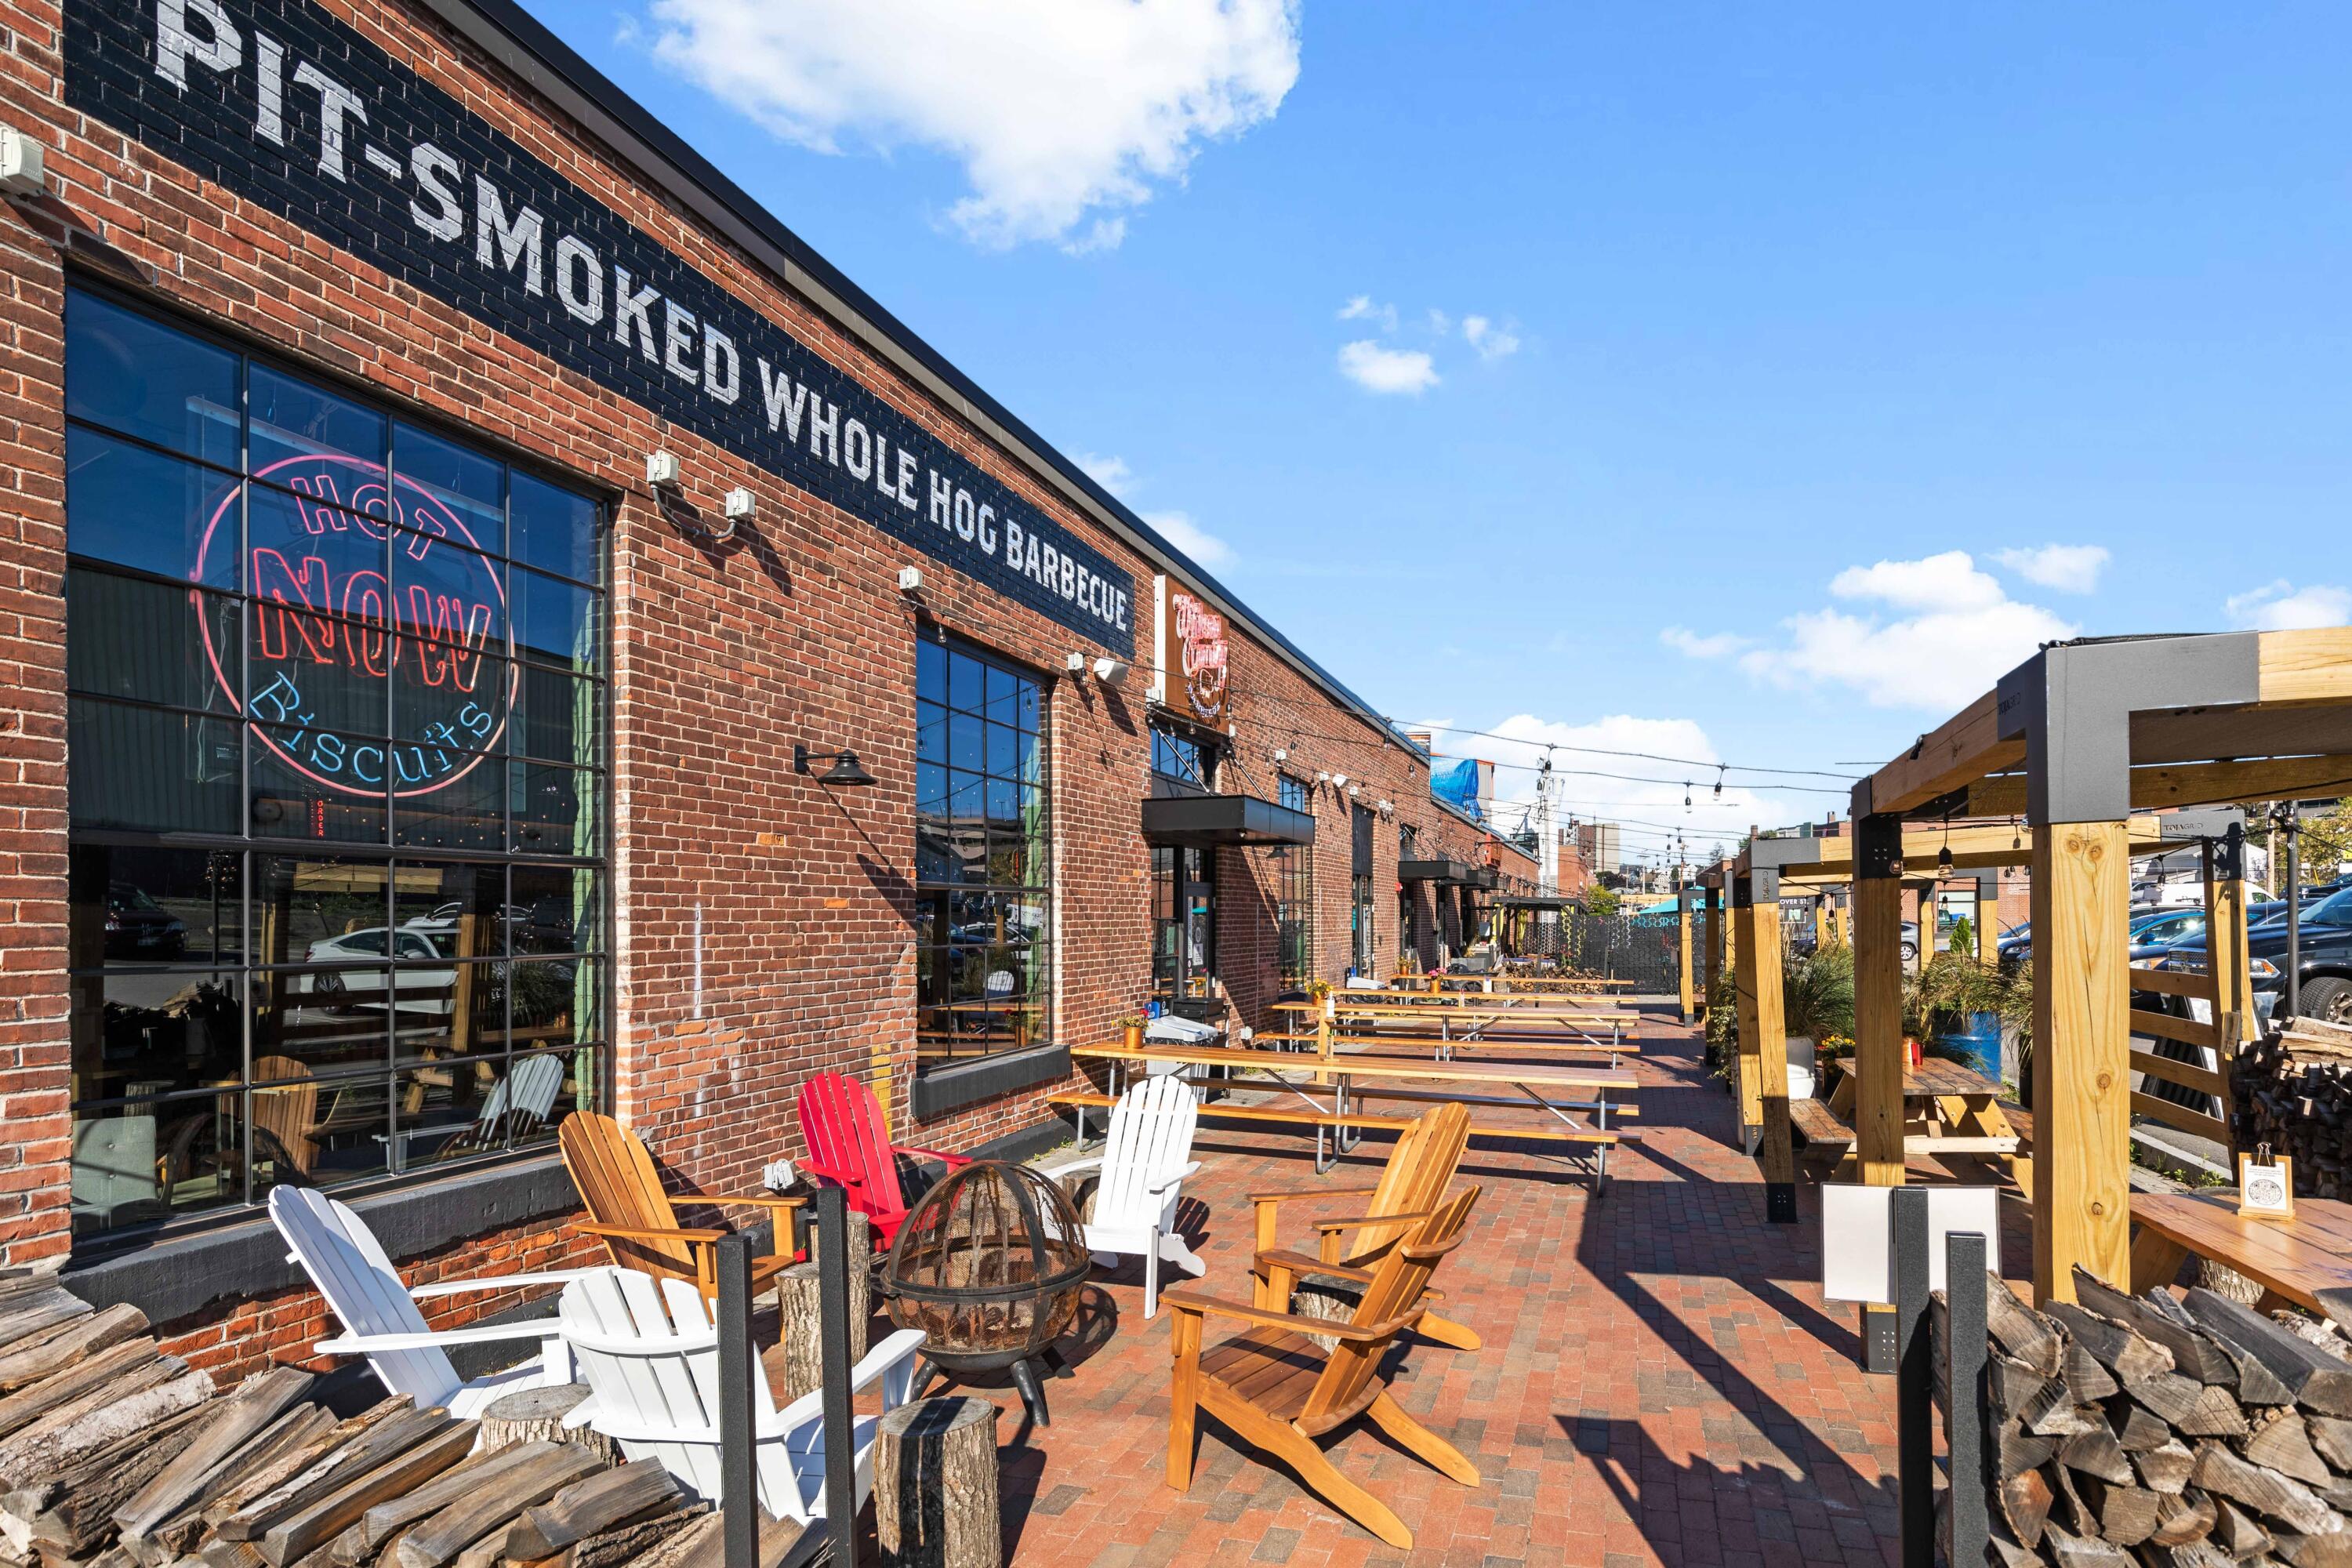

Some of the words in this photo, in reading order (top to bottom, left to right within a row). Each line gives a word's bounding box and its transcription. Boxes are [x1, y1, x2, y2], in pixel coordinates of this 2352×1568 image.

[154, 0, 740, 406] PIT-SMOKED
[757, 357, 919, 511] WHOLE
[929, 469, 997, 557] HOG
[1006, 517, 1129, 633] BARBECUE
[290, 474, 447, 561] HOT
[252, 547, 492, 693] NOW
[2163, 822, 2204, 831] TOJAGRD
